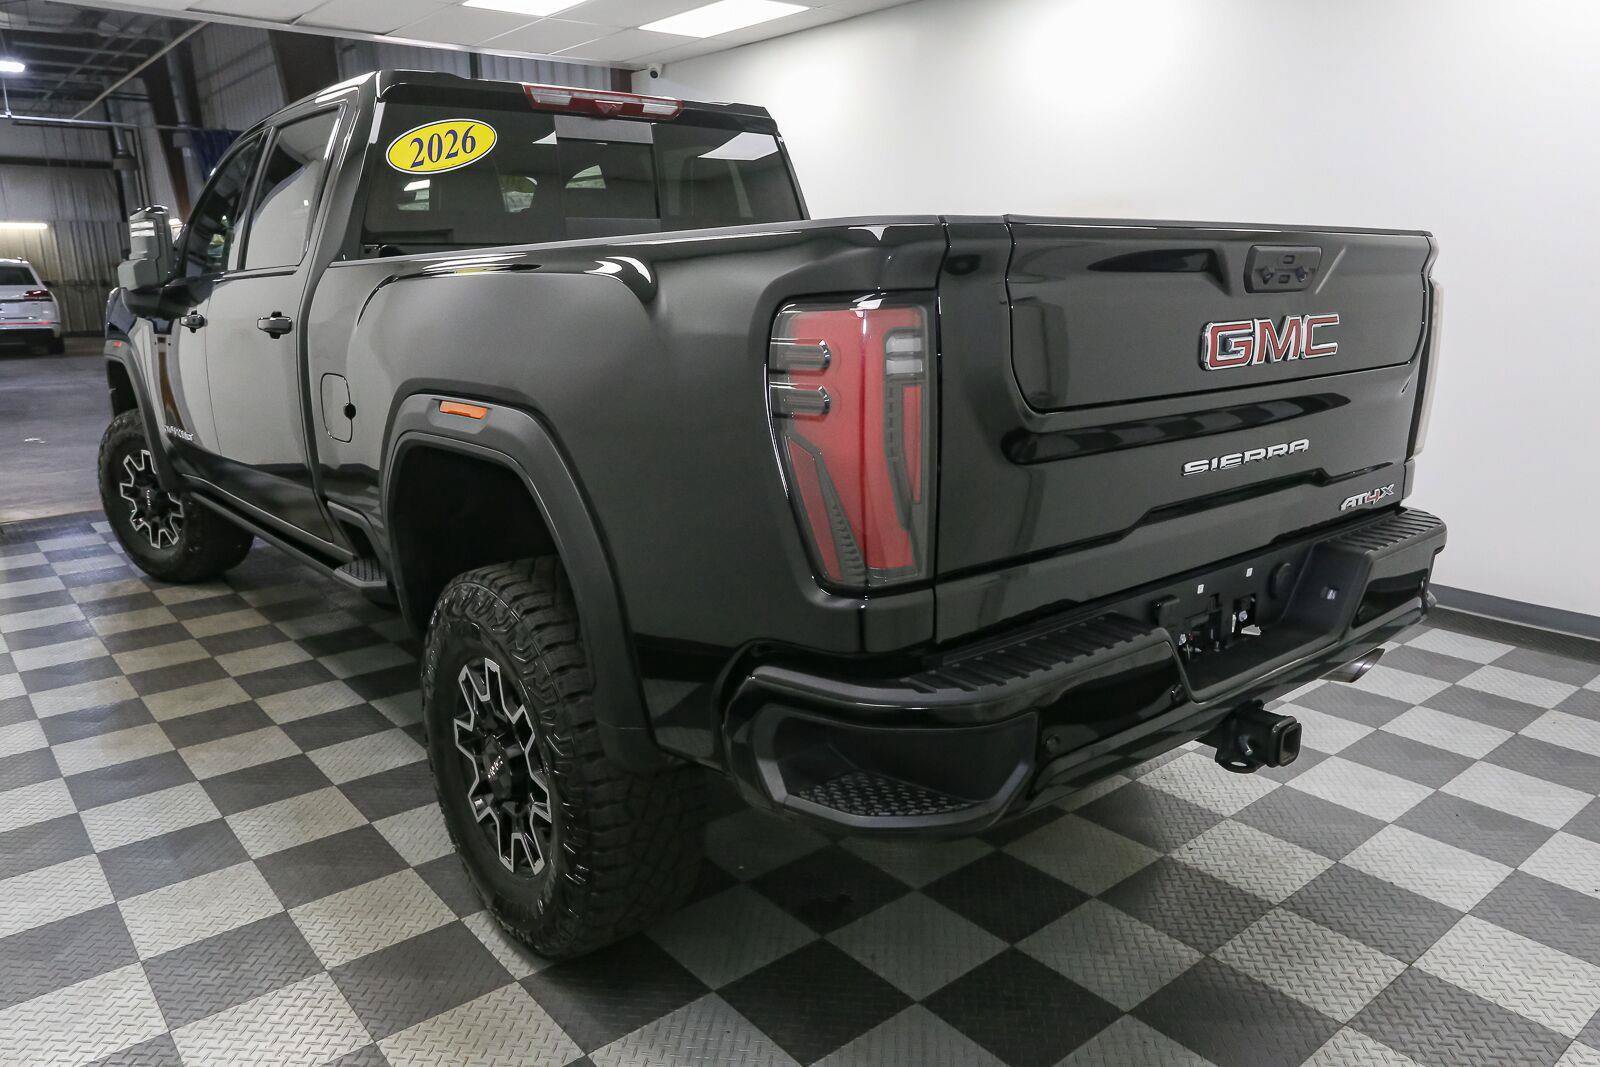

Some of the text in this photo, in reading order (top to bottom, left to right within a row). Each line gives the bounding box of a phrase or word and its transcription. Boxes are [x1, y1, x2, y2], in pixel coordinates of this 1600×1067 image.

[409, 124, 476, 168] 2026
[1202, 314, 1340, 371] GMC
[1182, 438, 1310, 476] SIERRA
[1340, 483, 1395, 511] AT4X
